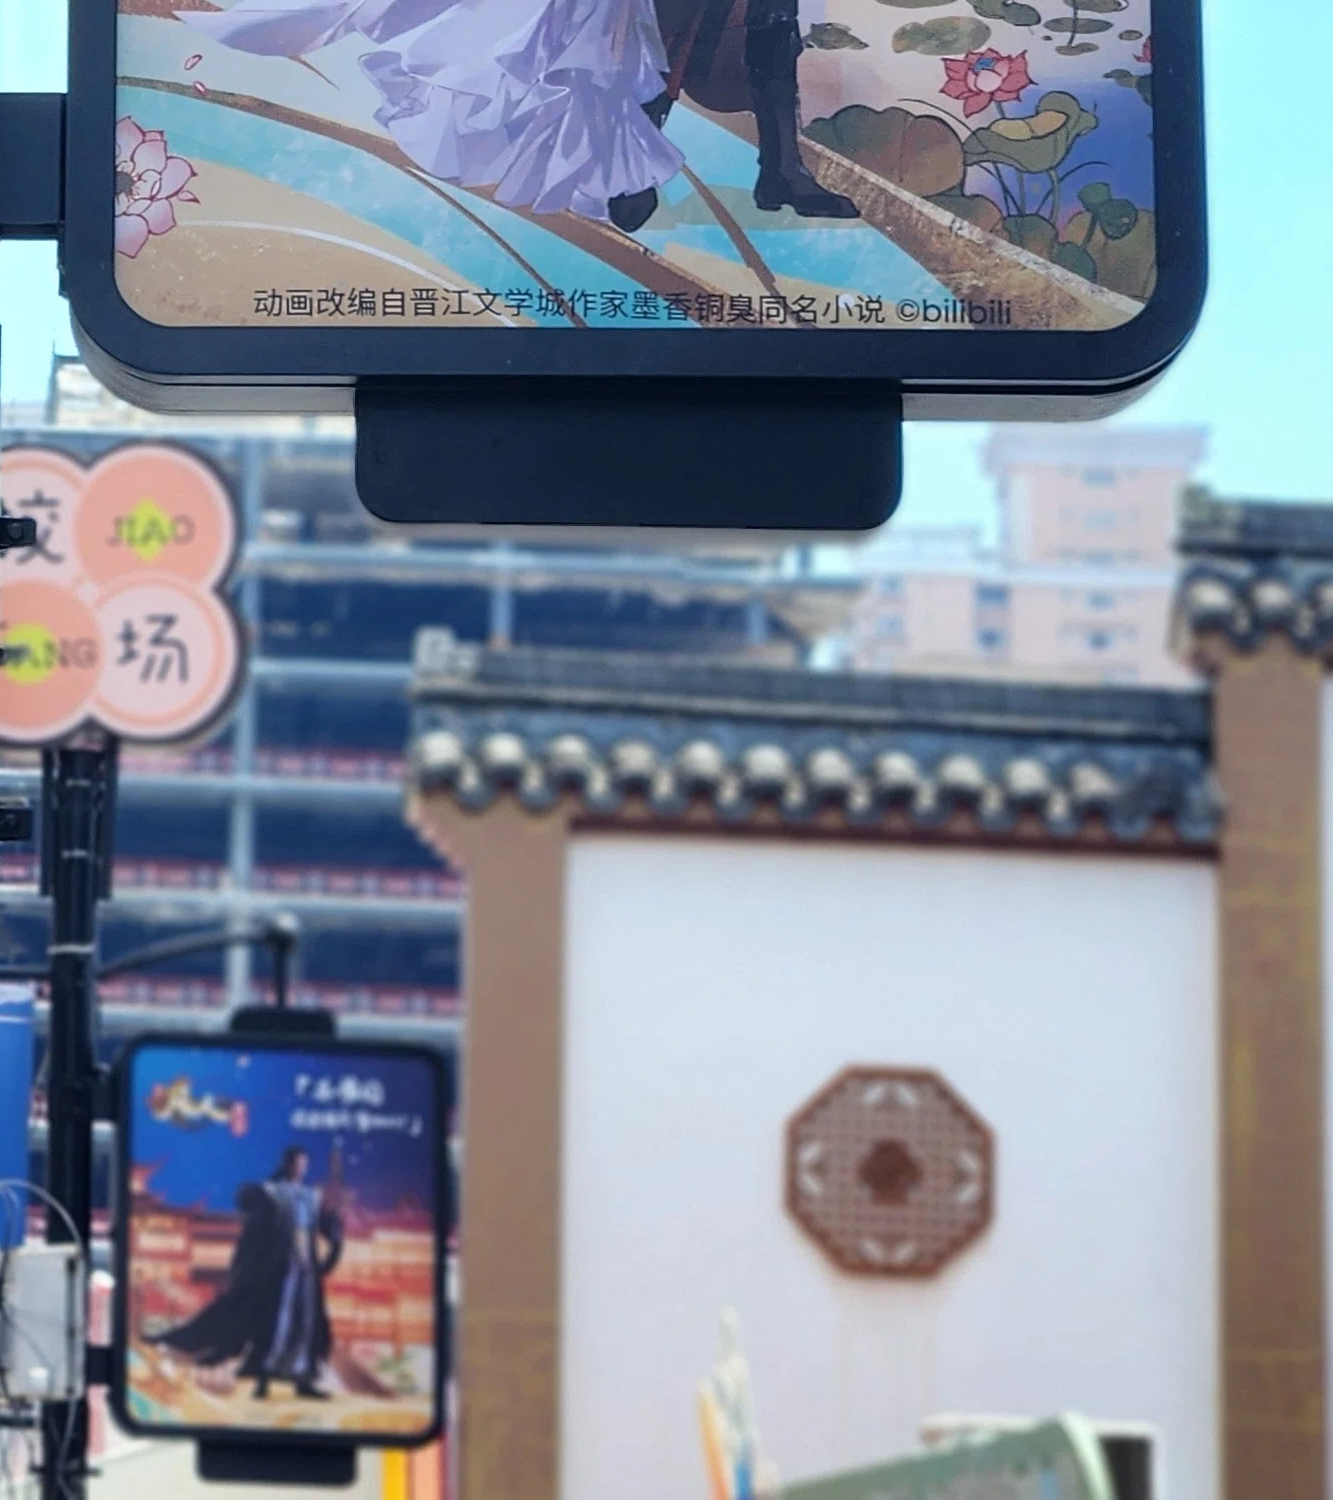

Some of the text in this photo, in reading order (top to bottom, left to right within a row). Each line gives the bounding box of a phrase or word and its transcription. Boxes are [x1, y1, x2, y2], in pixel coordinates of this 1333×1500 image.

[252, 288, 884, 324] 动画改编自晋江文学城作家墨香铜臭同名小说
